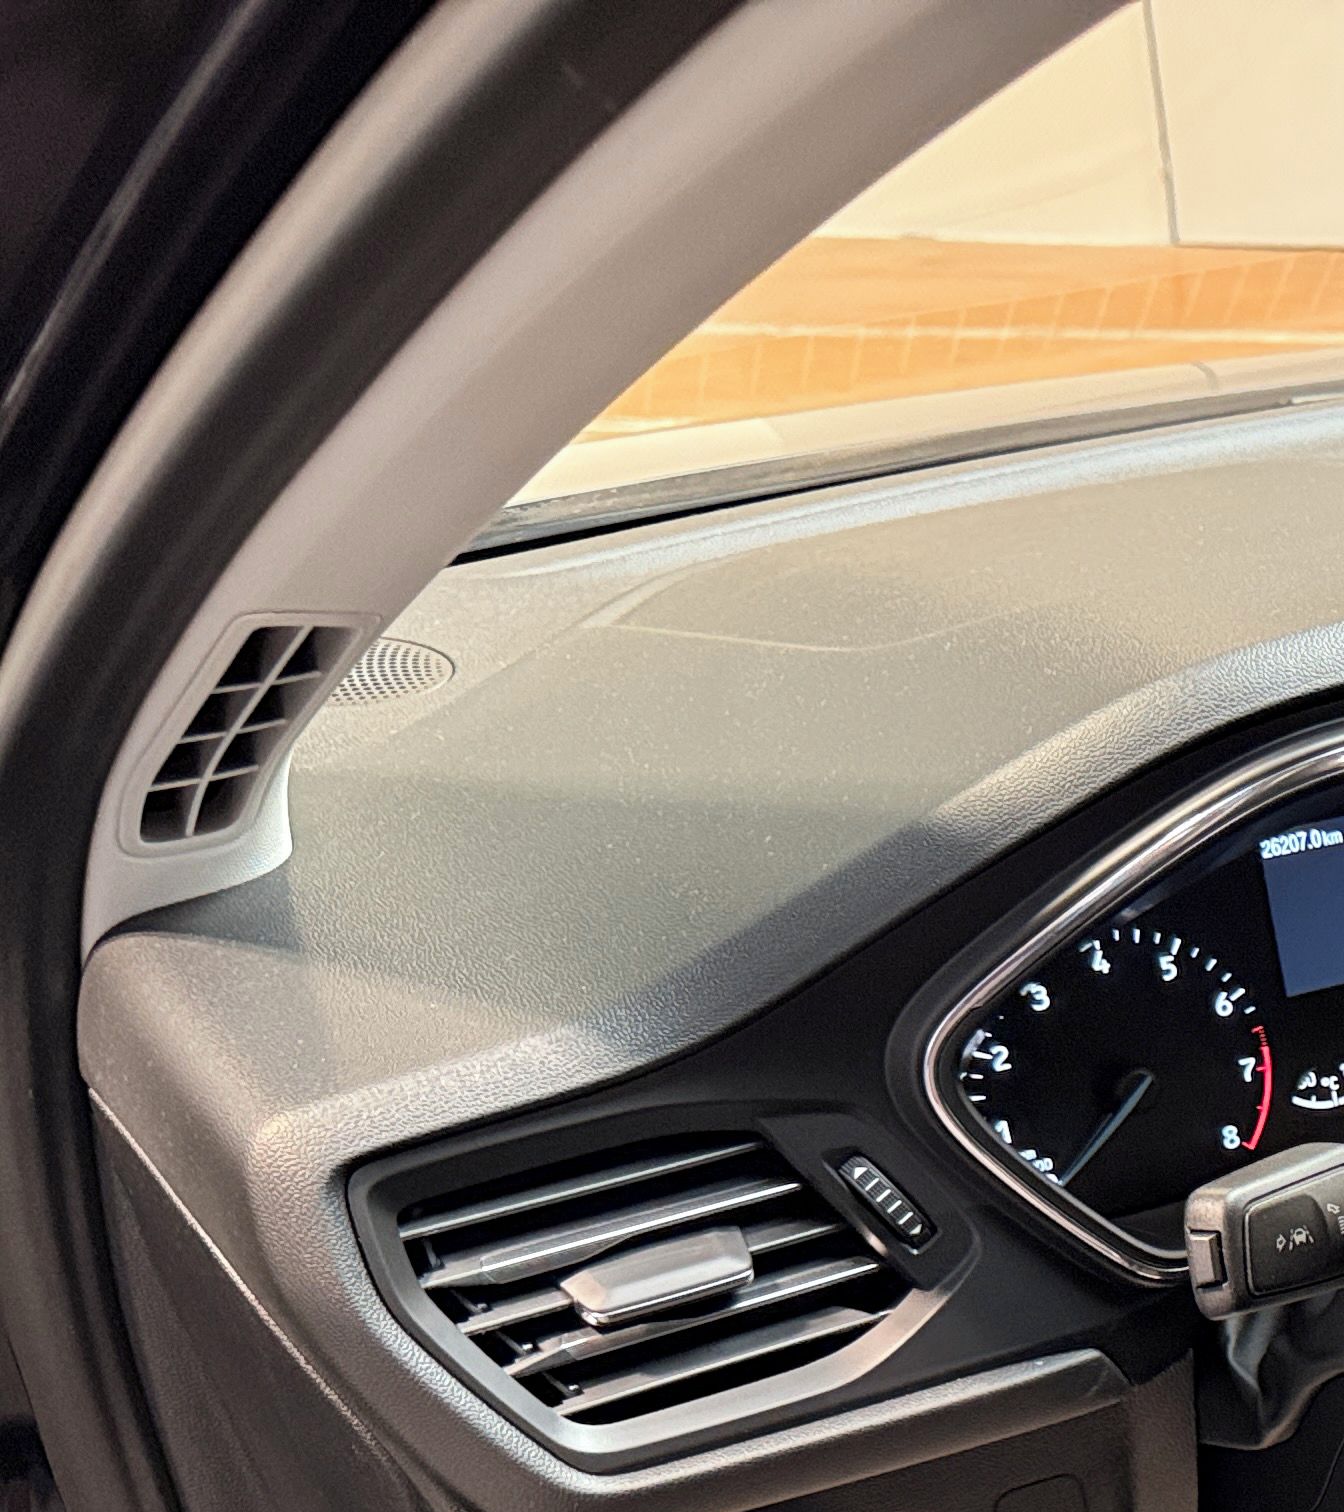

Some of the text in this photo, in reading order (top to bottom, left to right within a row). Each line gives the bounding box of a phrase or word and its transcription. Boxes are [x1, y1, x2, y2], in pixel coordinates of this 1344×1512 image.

[1090, 949, 1111, 974] 4
[1159, 955, 1178, 982] 5
[1019, 982, 1051, 1012] 3
[1215, 991, 1233, 1017] 6
[990, 1045, 1012, 1072] 2
[1238, 1056, 1256, 1082] 7
[994, 1119, 1013, 1144] 1
[1222, 1124, 1241, 1149] 8
